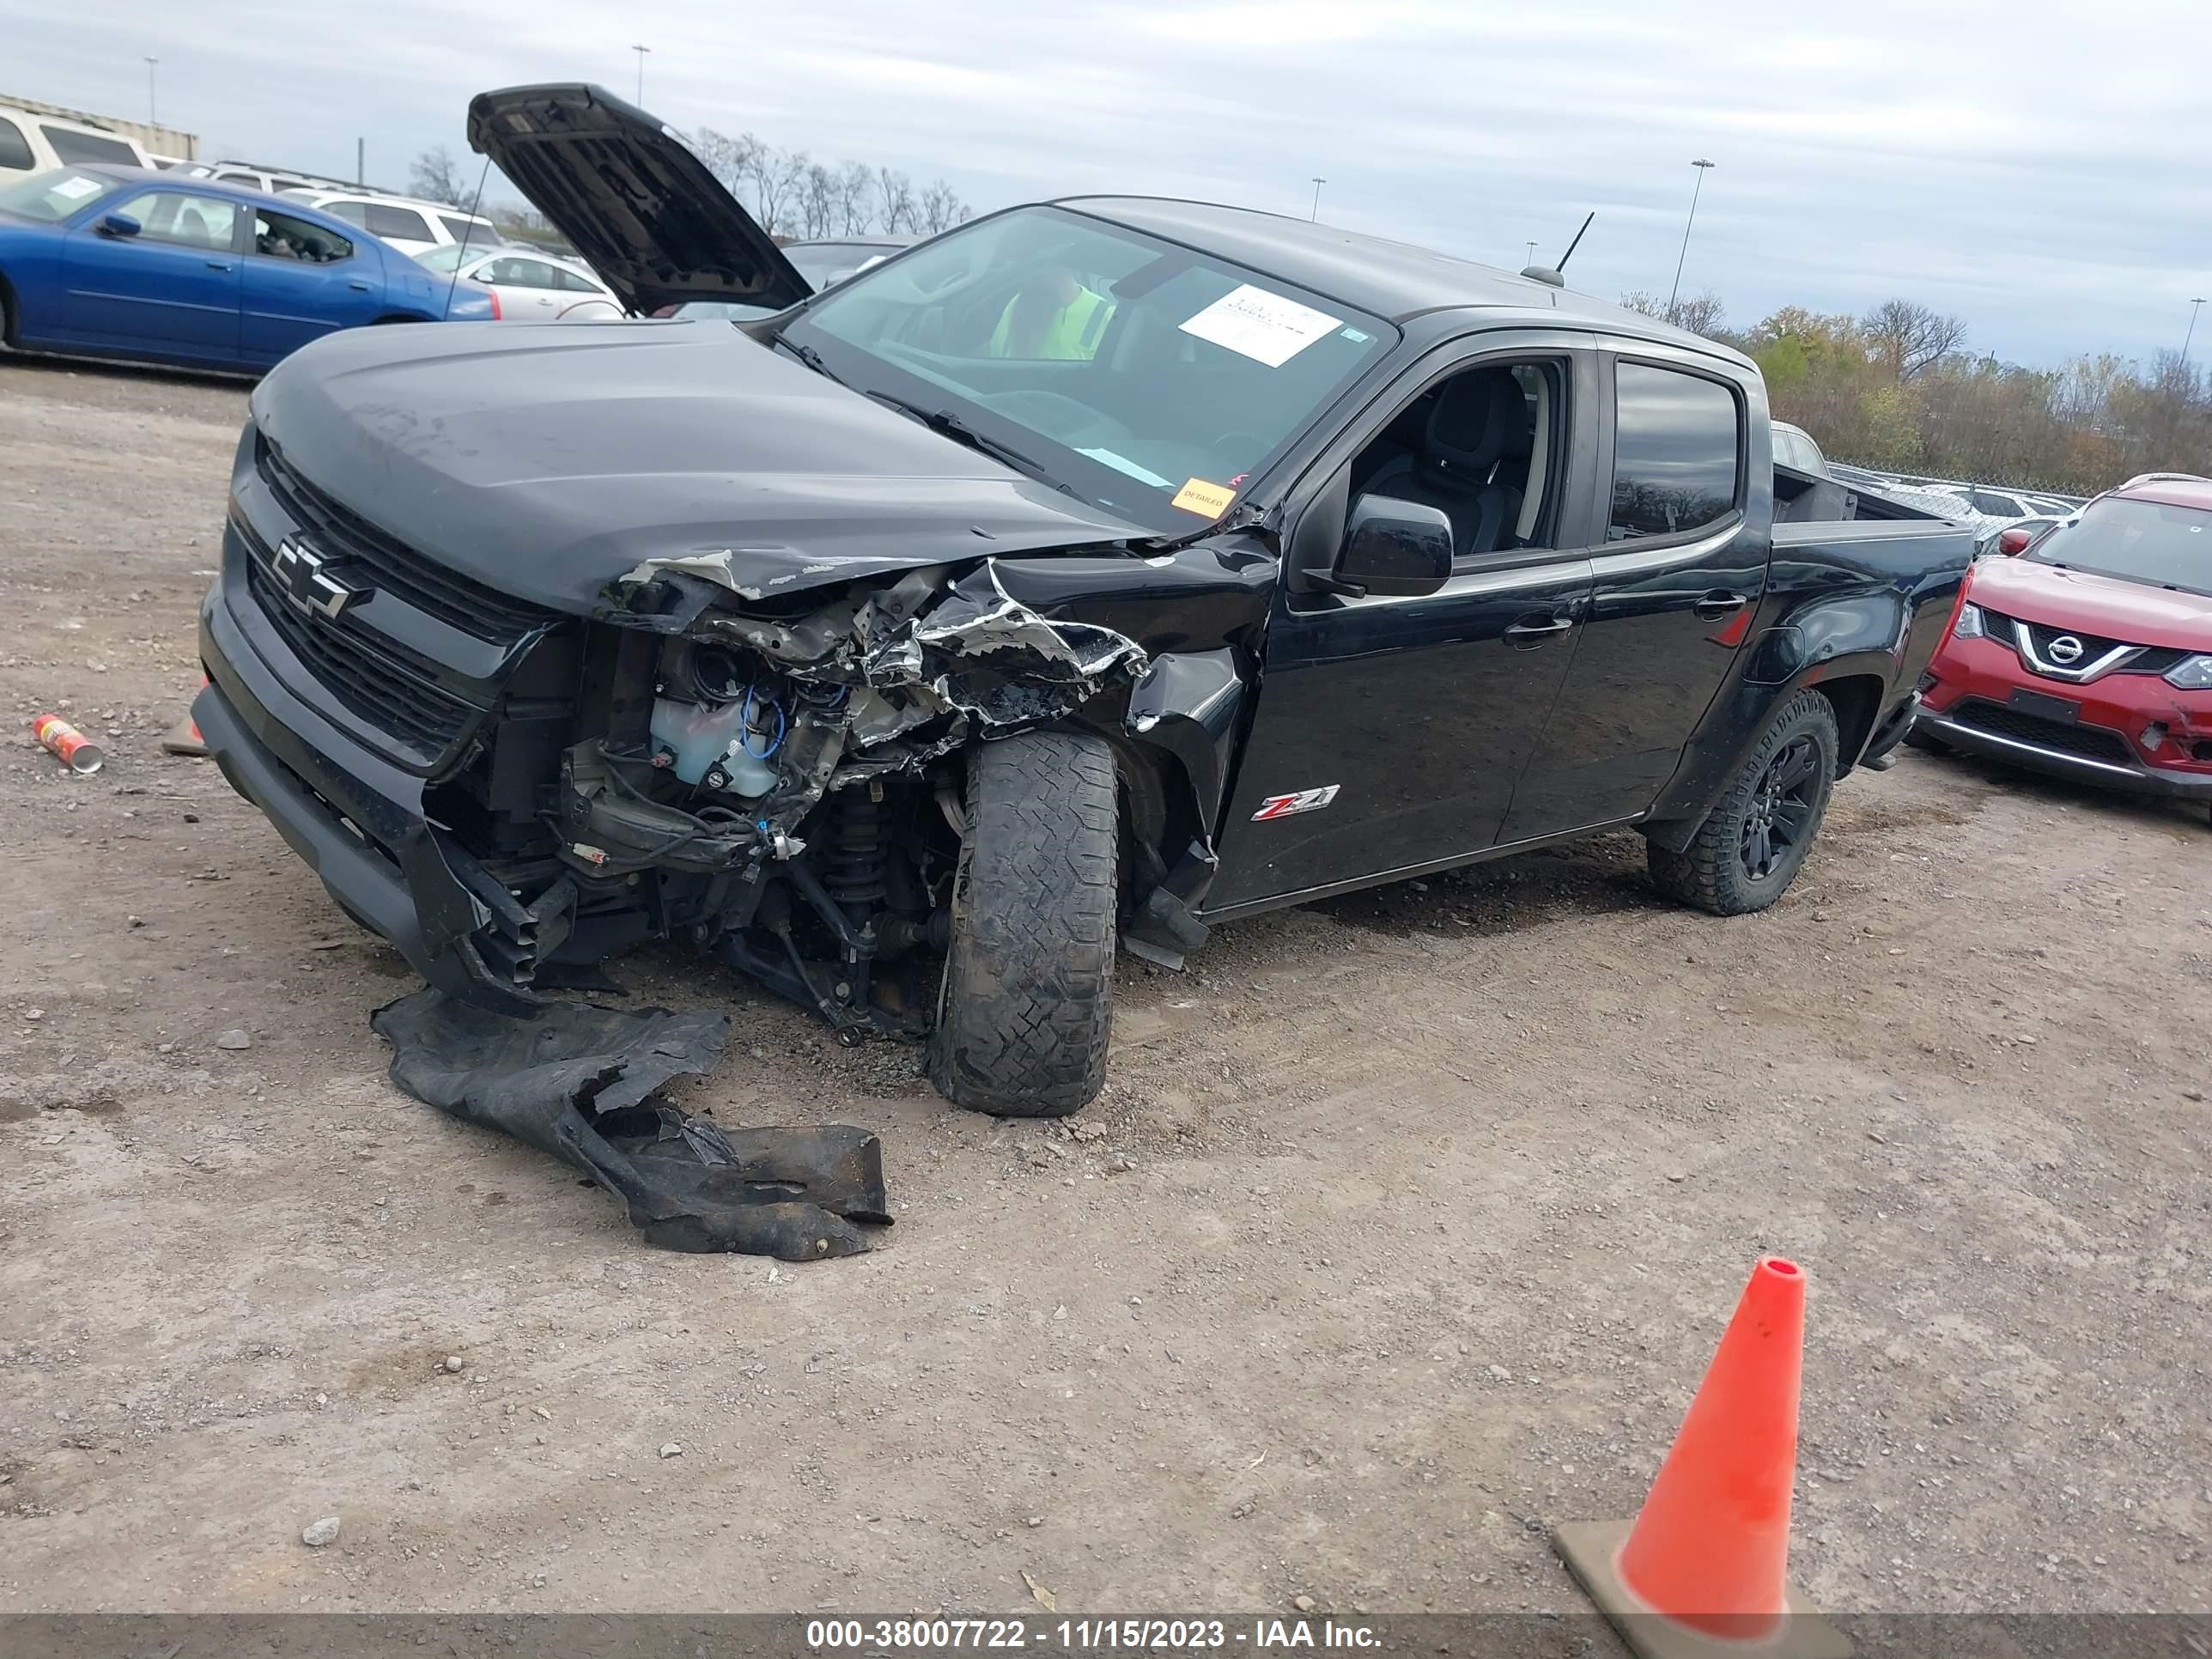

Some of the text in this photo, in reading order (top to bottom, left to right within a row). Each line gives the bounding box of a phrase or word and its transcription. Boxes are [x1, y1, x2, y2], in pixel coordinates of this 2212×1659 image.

[1183, 490, 1223, 507] DETAILED
[2051, 645, 2079, 655] NISSAN
[1250, 783, 1341, 822] Z71
